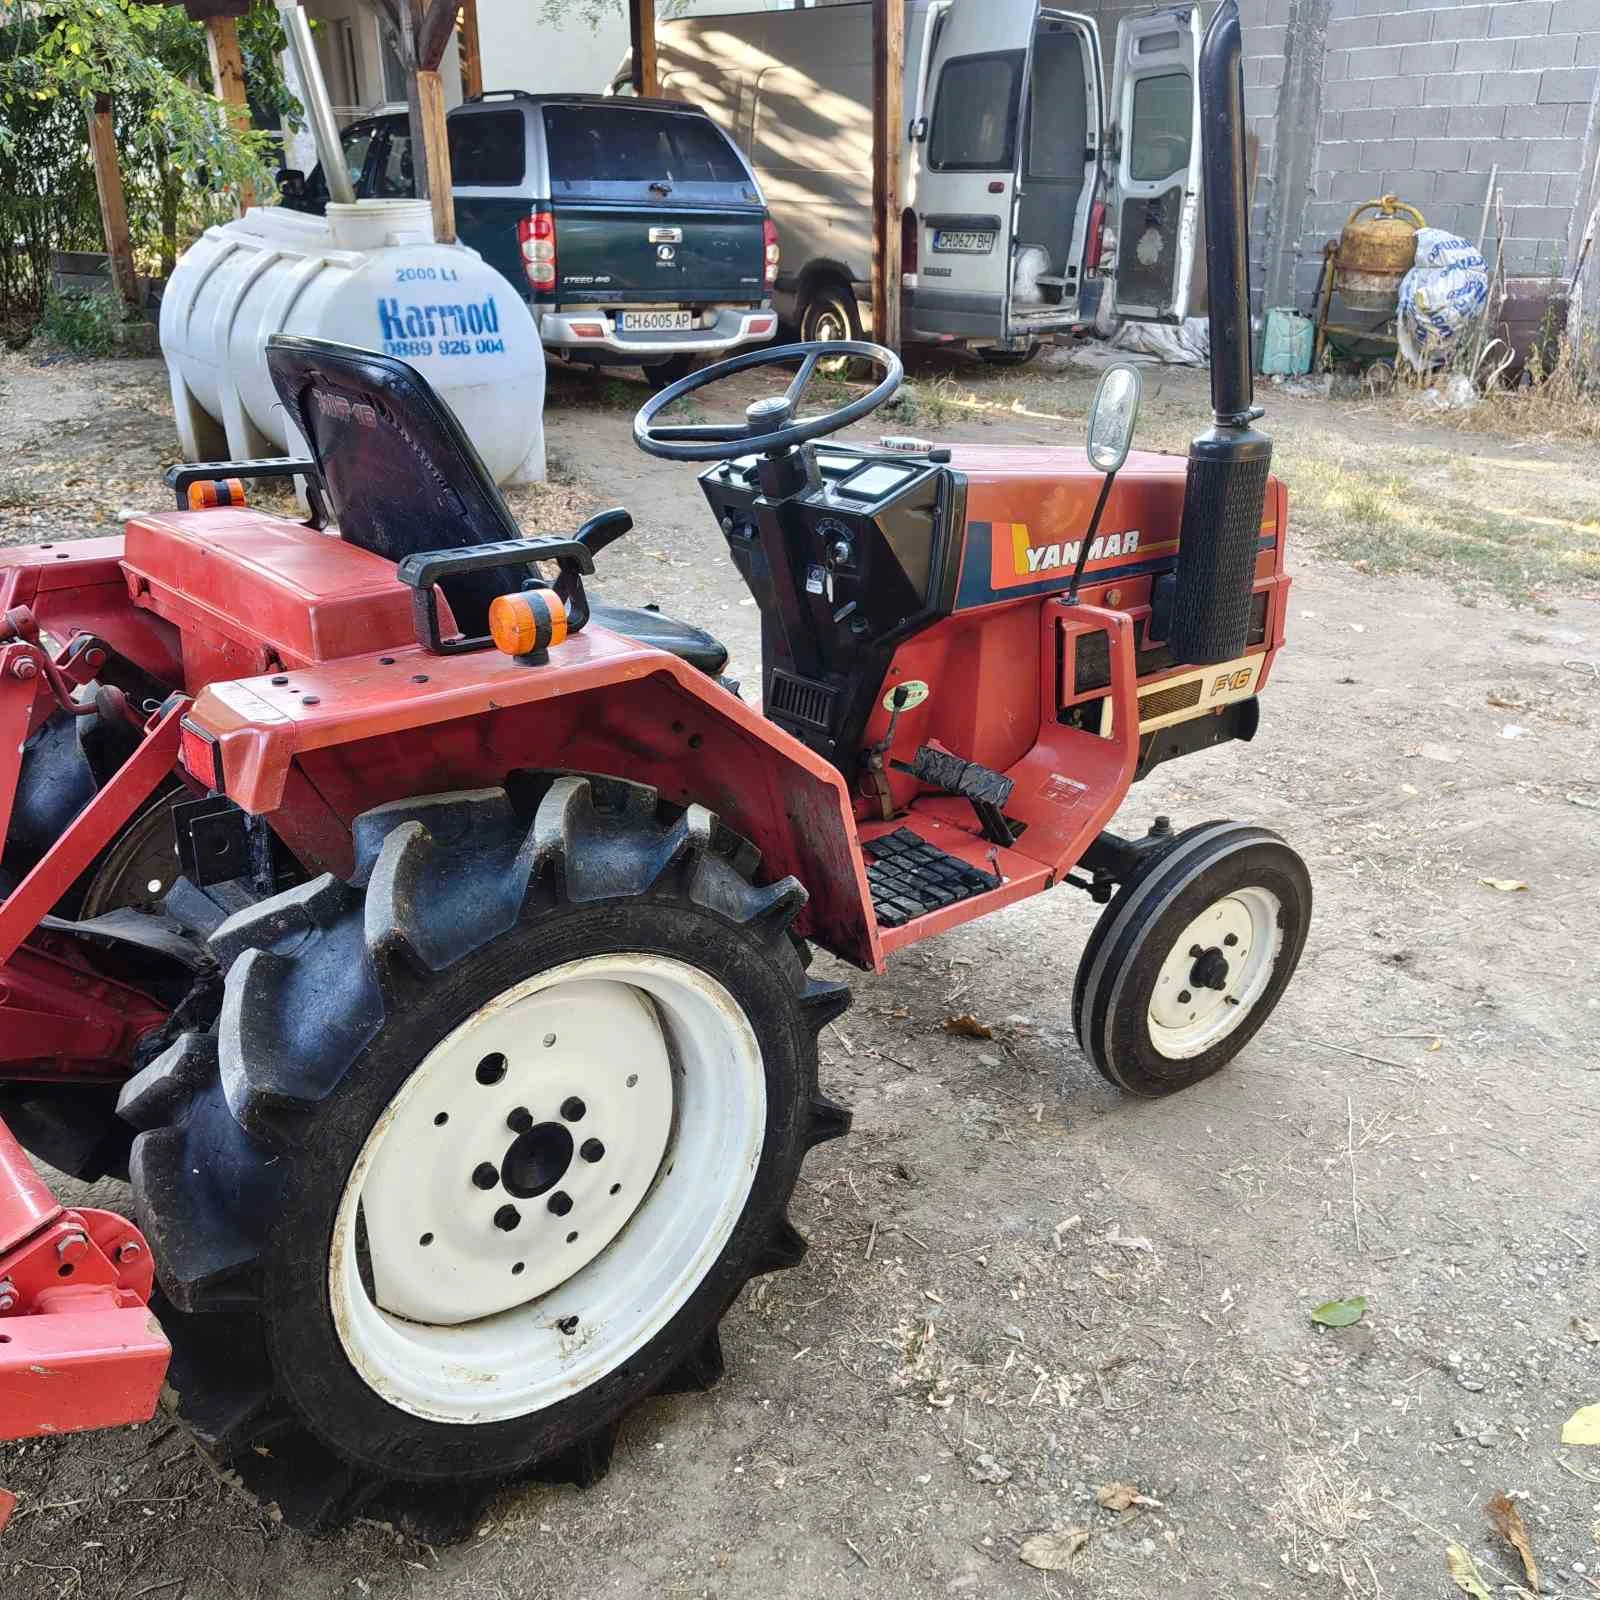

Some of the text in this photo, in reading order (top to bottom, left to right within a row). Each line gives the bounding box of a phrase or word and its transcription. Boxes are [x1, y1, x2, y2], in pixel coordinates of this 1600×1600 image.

[396, 267, 436, 282] 2000
[377, 294, 499, 340] Karmod
[383, 339, 505, 356] 0889 926 004
[1026, 530, 1140, 571] YANMAR
